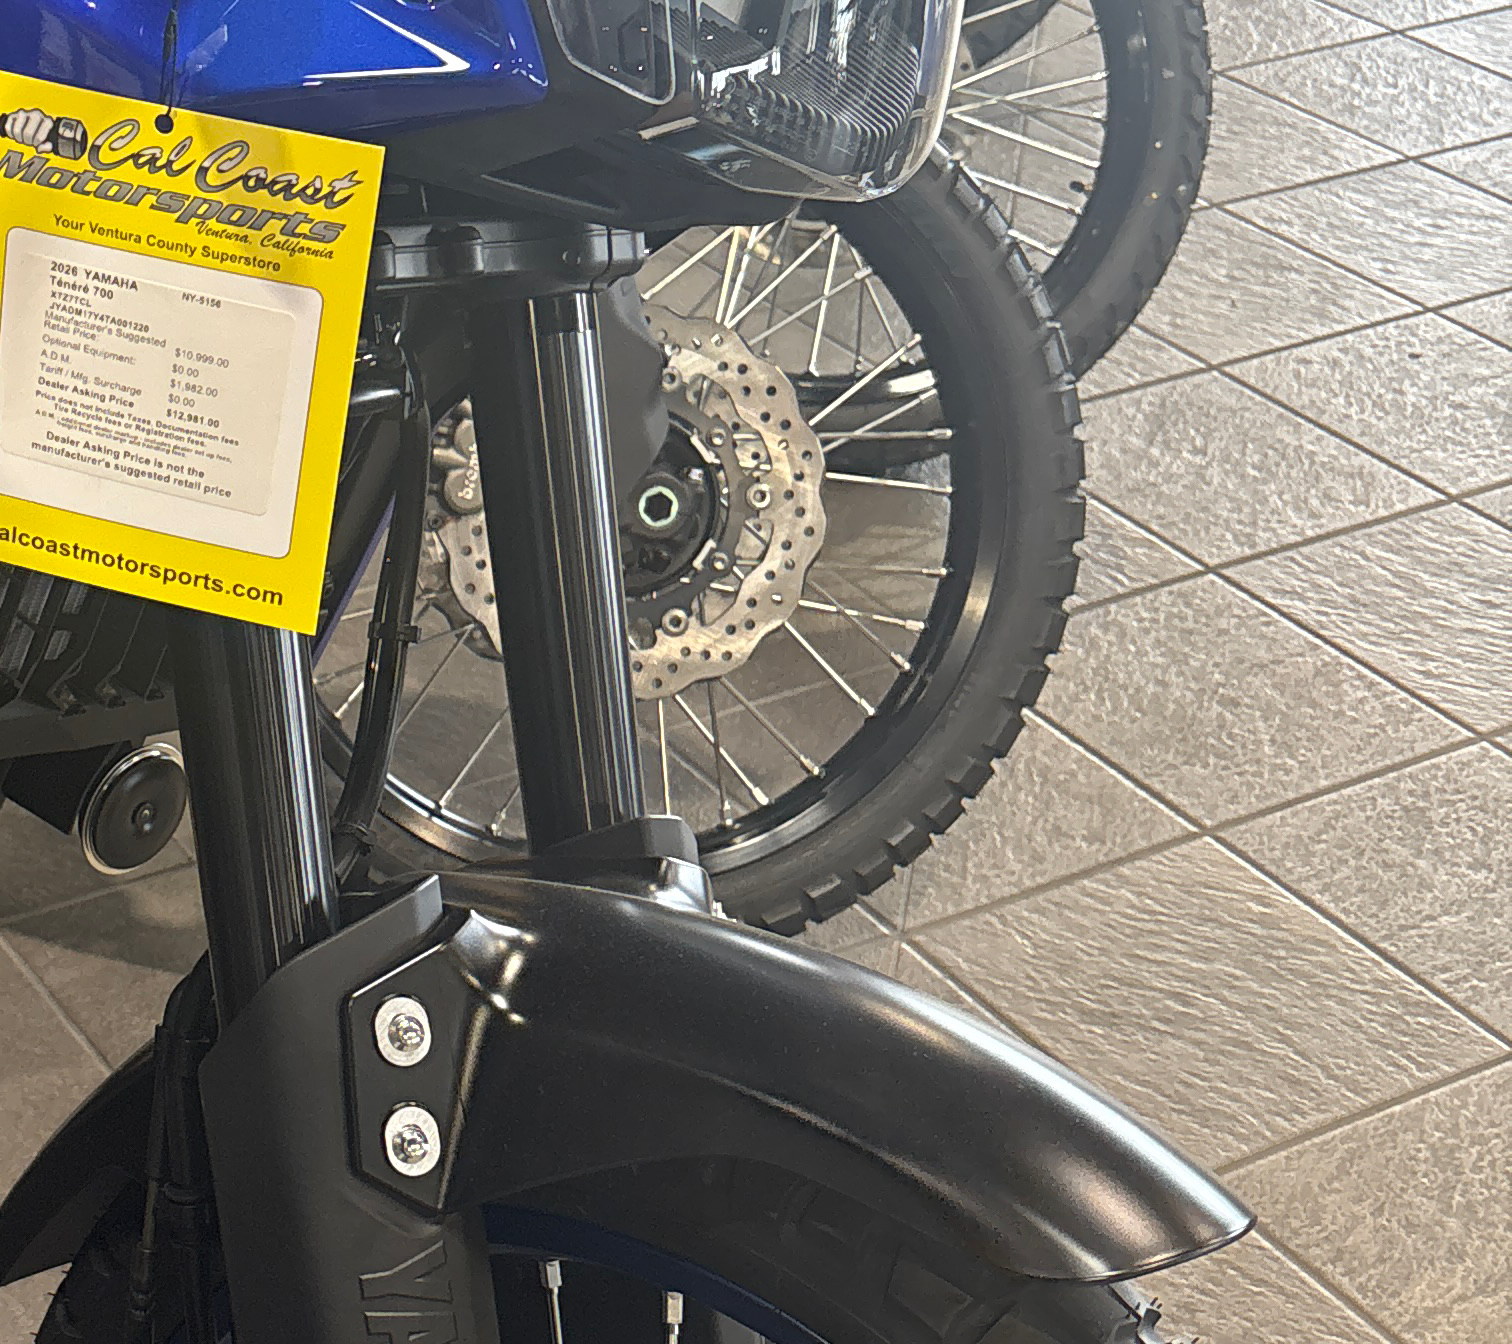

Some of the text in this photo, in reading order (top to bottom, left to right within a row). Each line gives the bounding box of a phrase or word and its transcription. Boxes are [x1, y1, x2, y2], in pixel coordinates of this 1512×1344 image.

[88, 118, 364, 209] Cal Coast
[53, 214, 281, 272] Your Ventura County Superstore
[260, 233, 334, 259] California
[50, 261, 138, 292] 2026 YAMAHA
[93, 286, 114, 300] 700
[42, 334, 80, 352] Optional
[115, 328, 166, 348] Suggested
[38, 376, 134, 408] Dealer Asking Price
[93, 376, 142, 396] Surcharge
[31, 441, 231, 498] manufacturer's suggested retail price
[46, 430, 204, 478] Dealer Asking Price is not the
